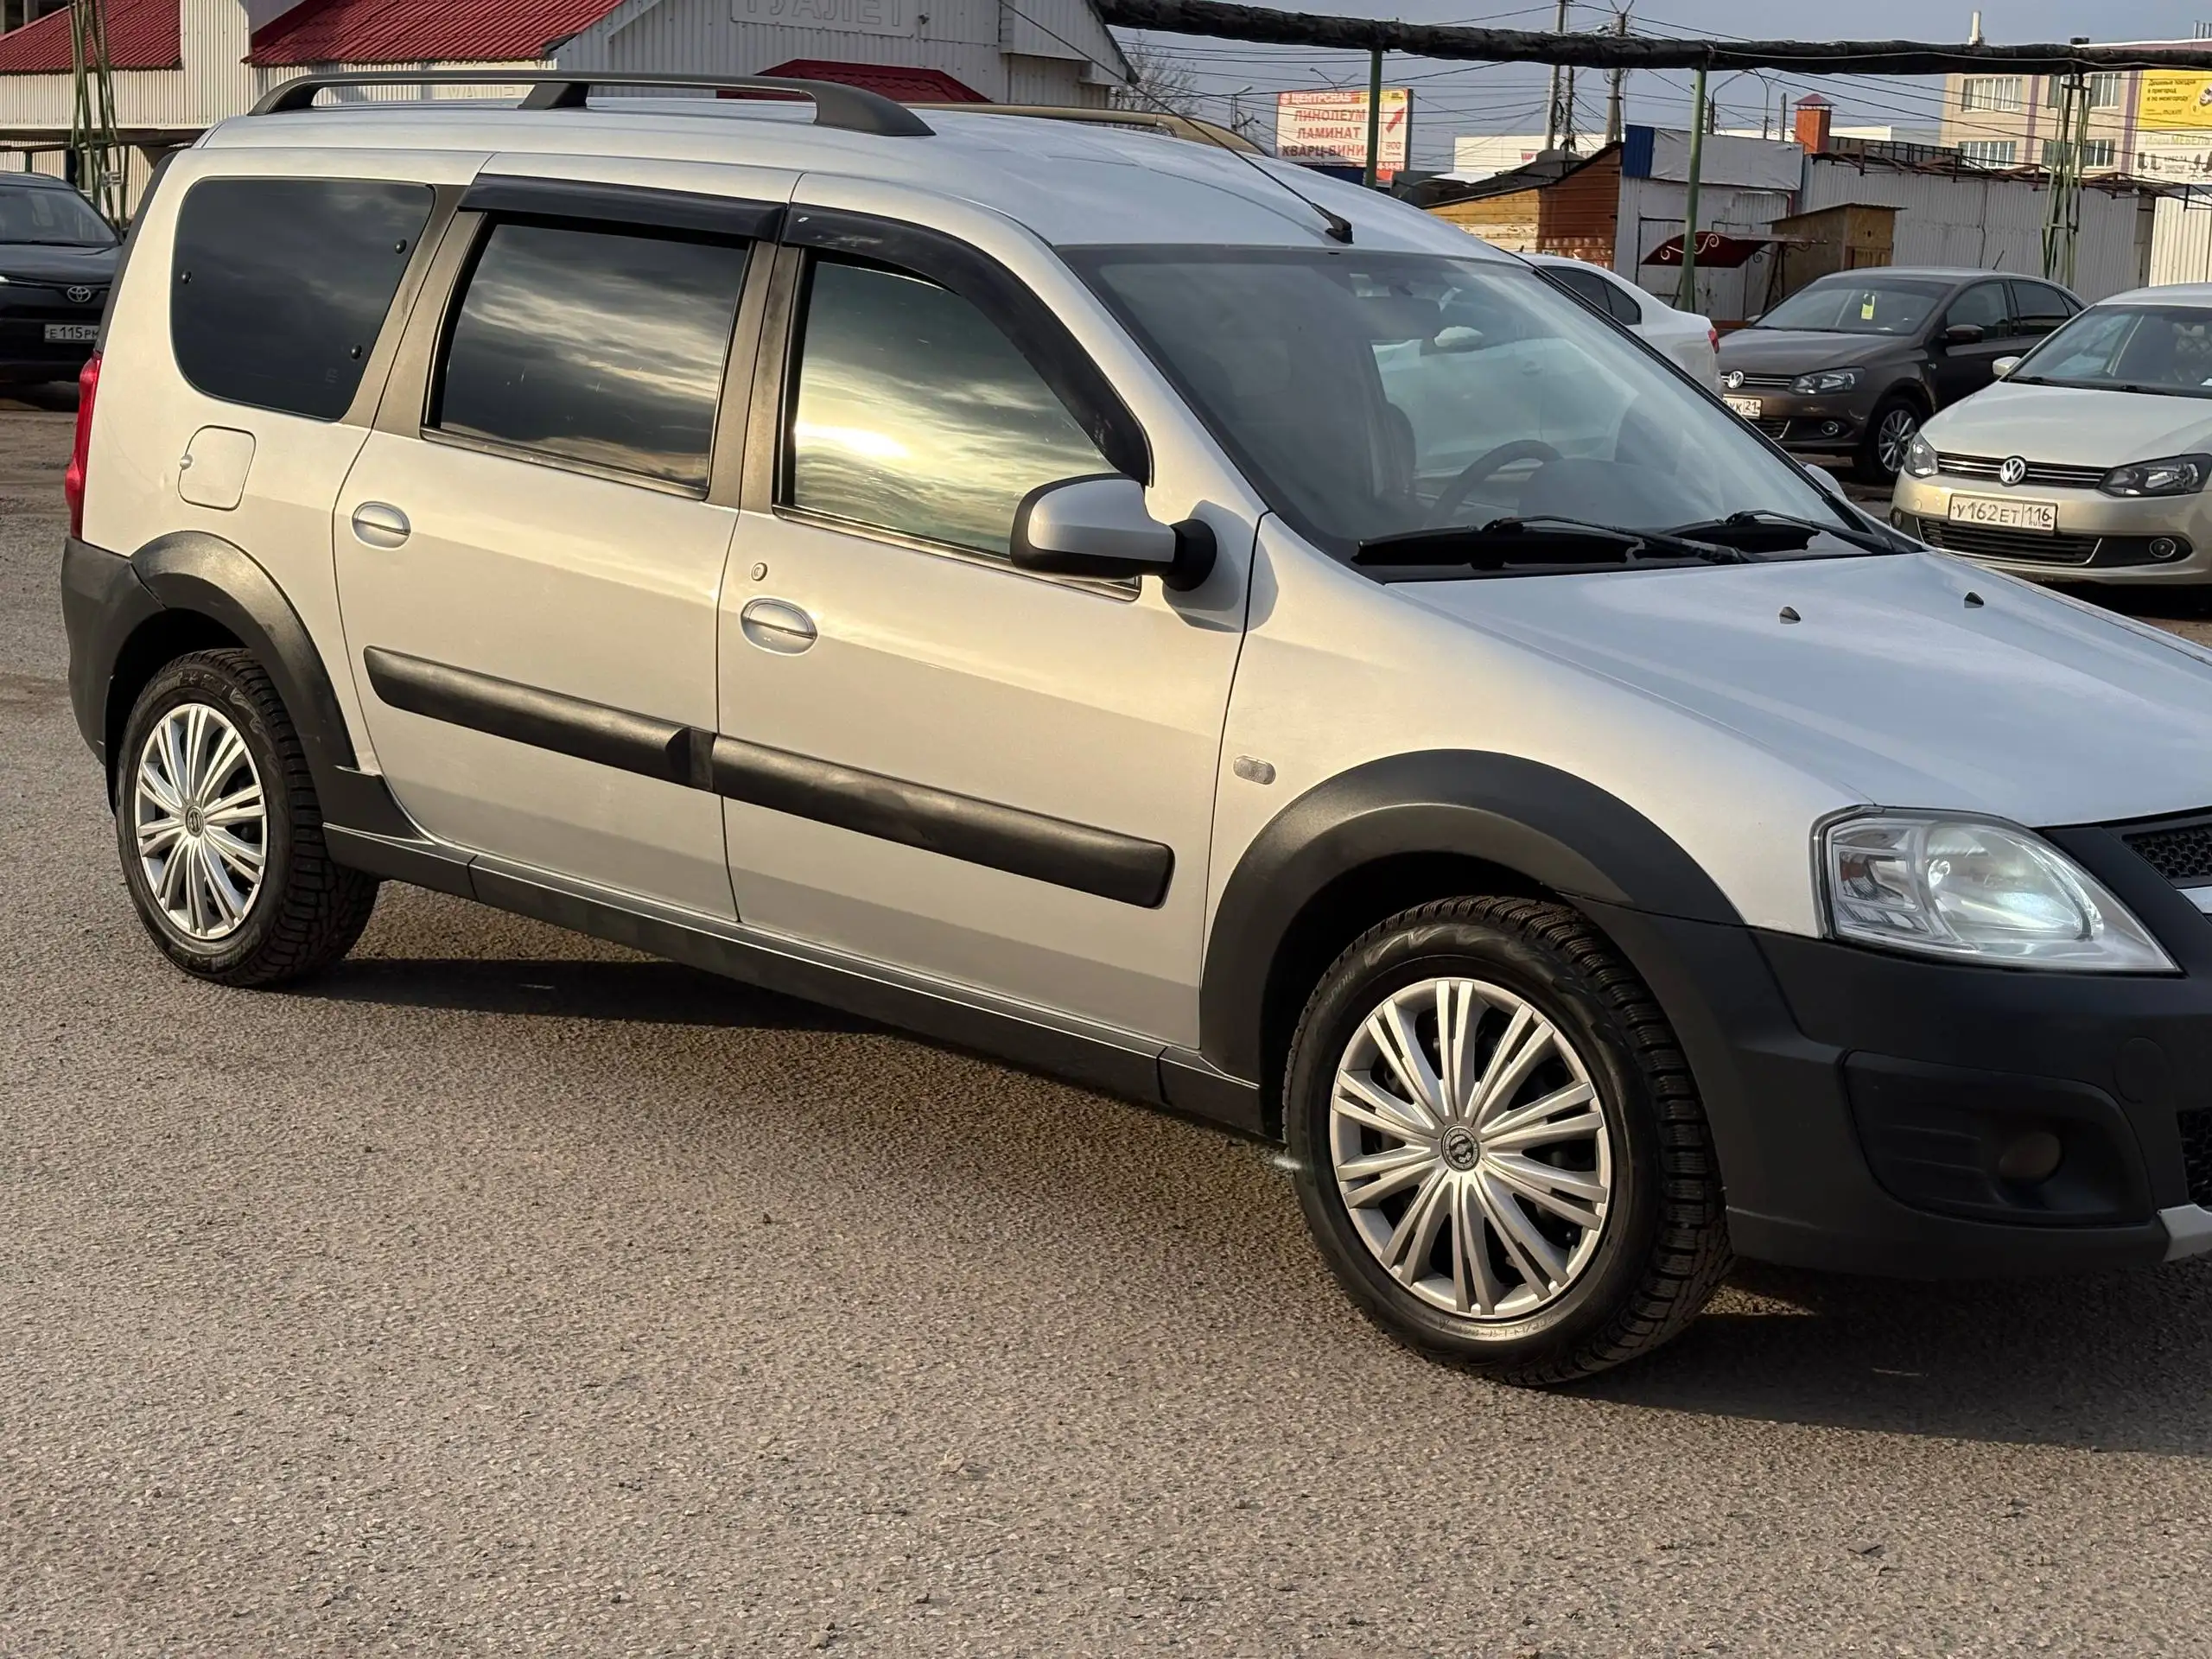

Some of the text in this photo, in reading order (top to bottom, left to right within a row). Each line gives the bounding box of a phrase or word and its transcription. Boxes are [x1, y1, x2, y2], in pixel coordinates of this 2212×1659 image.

[1294, 109, 1366, 123] ЛИНОЛЕУМ
[1297, 127, 1361, 139] ЛАМИНАТ
[1282, 144, 1368, 158] КВАРЦ-ВИНИ
[1956, 501, 2050, 524] У162ЕТ 116
